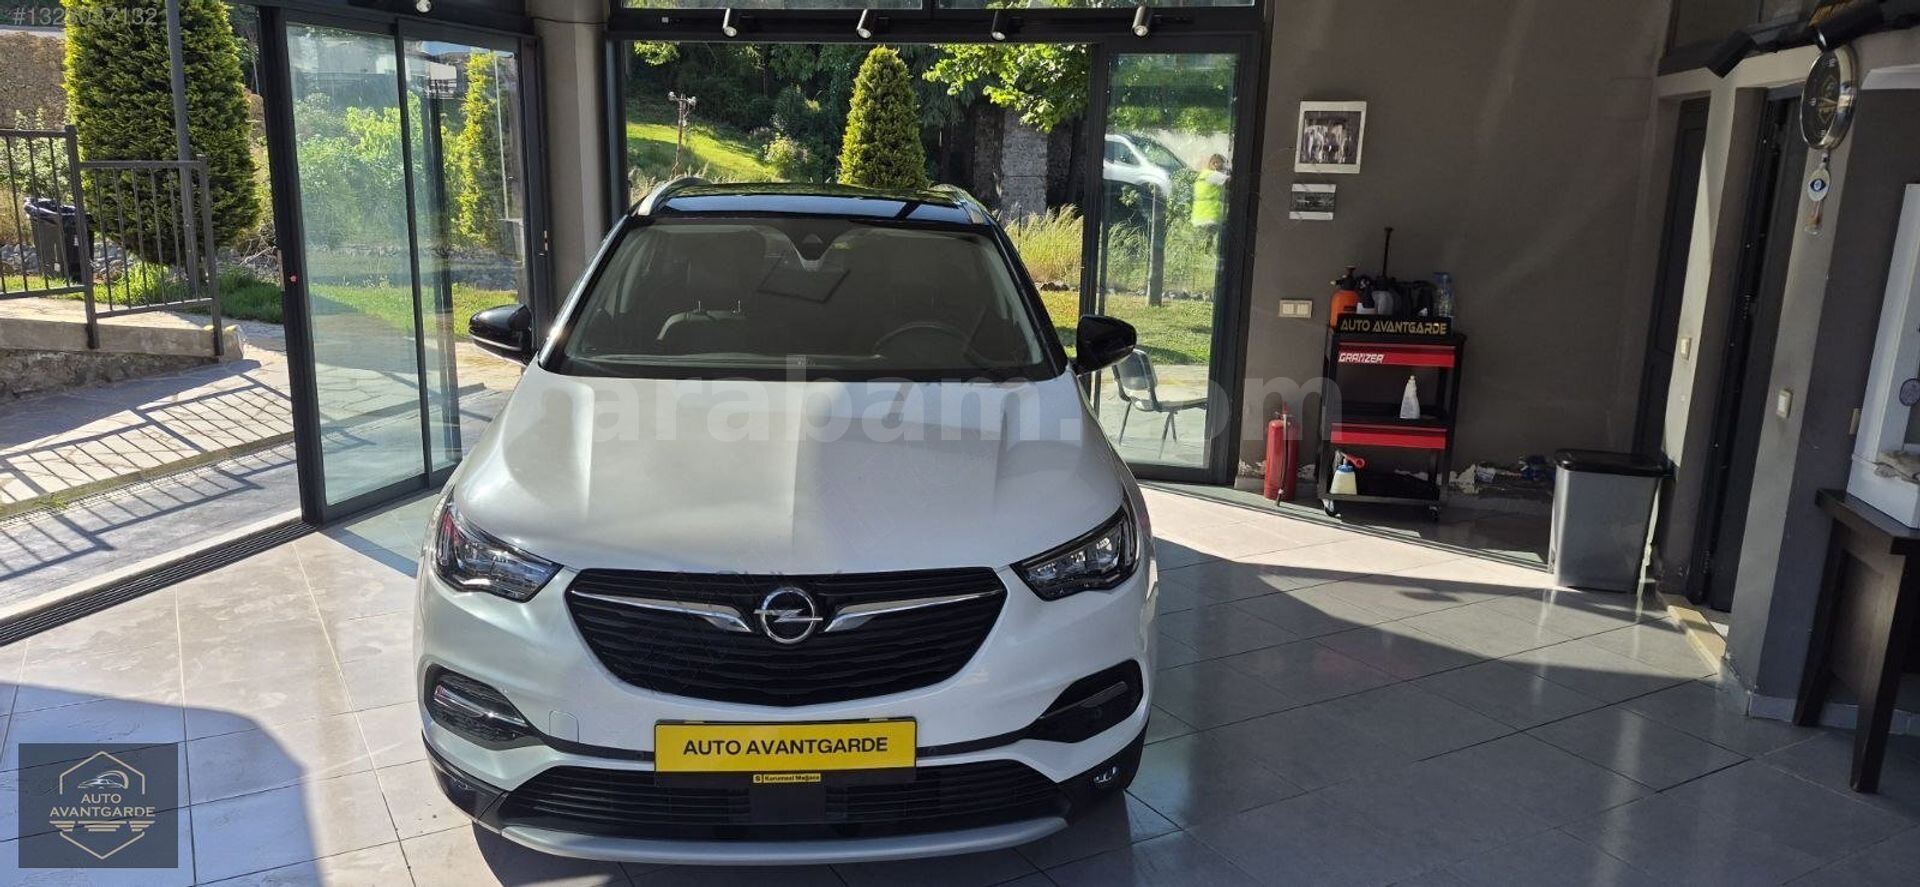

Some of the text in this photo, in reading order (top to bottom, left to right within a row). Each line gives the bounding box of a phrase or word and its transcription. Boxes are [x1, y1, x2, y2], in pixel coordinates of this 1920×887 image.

[1340, 319, 1448, 335] AUTO AVANTGARDE
[1338, 352, 1385, 364] GRANZER
[683, 737, 889, 755] AUTO AVANTGARDE
